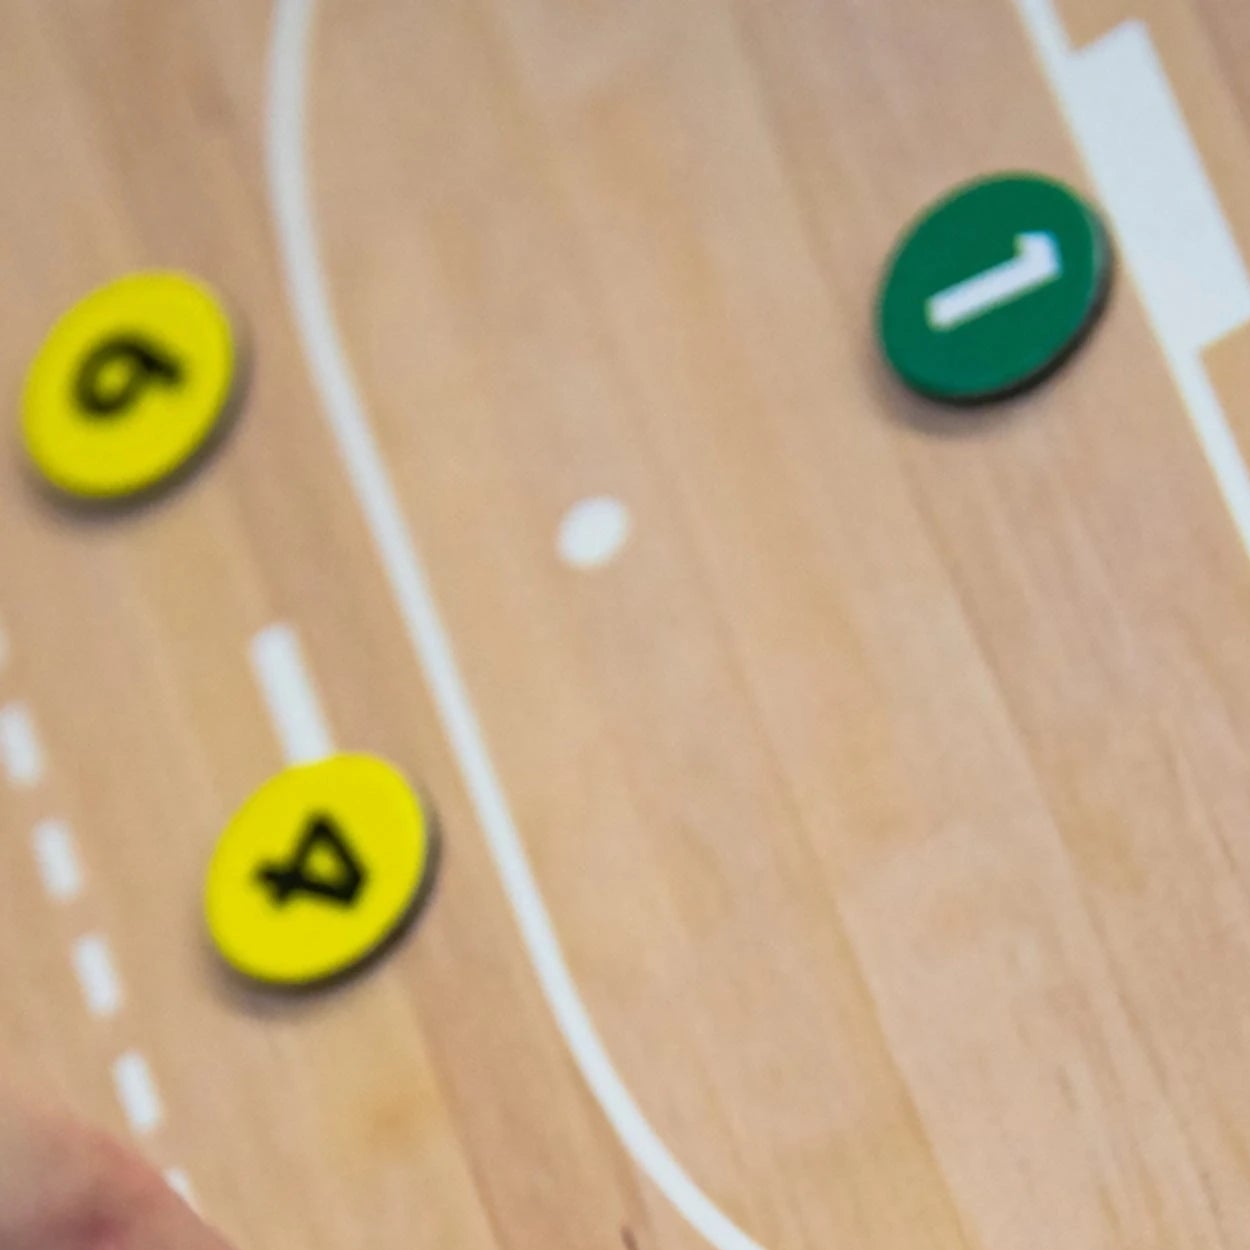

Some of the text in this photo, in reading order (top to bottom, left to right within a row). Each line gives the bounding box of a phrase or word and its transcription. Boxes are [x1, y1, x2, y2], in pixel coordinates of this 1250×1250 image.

[924, 229, 1063, 333] 1
[71, 332, 186, 420] 6
[252, 811, 369, 909] 4
